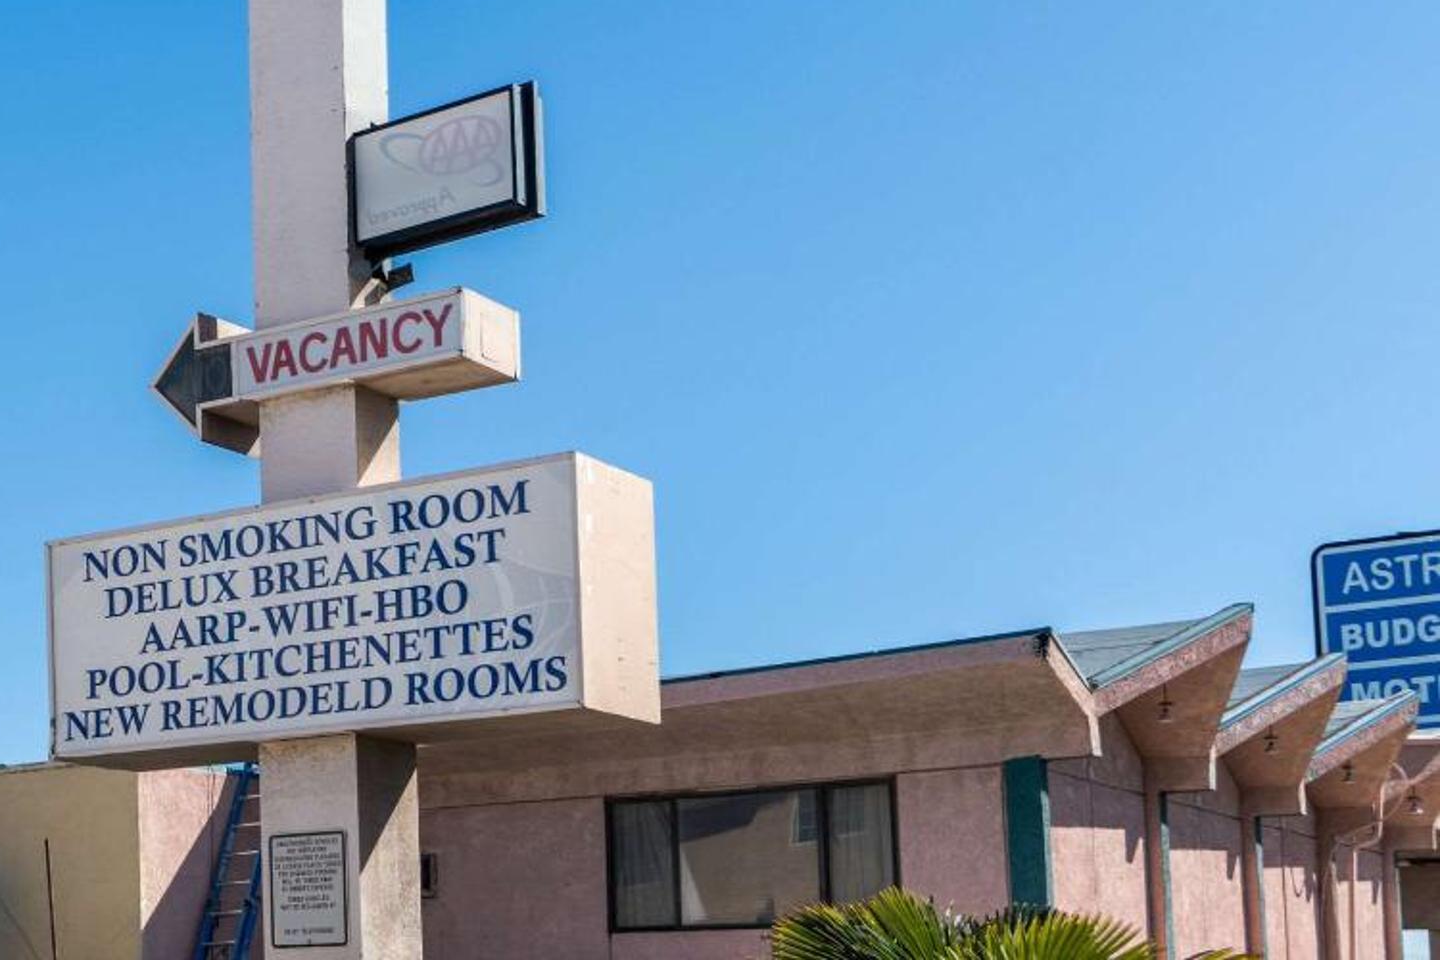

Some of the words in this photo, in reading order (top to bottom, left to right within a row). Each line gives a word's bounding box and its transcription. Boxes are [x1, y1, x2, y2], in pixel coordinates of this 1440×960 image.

[247, 303, 454, 384] VACANCY
[82, 539, 167, 583] NON
[178, 505, 378, 568] SMOKING
[387, 479, 531, 535] ROOM
[104, 569, 240, 619] DELUX
[250, 527, 506, 598] BREAKFAST
[85, 613, 535, 700] POOL-KITCHENETTES
[139, 578, 470, 655] AARP-WIFI-HBO
[1340, 614, 1440, 651] BUDG
[63, 703, 151, 742] NEW
[160, 676, 393, 732] REMODELD
[403, 655, 568, 711] ROOMS
[1350, 675, 1440, 704] MOT
